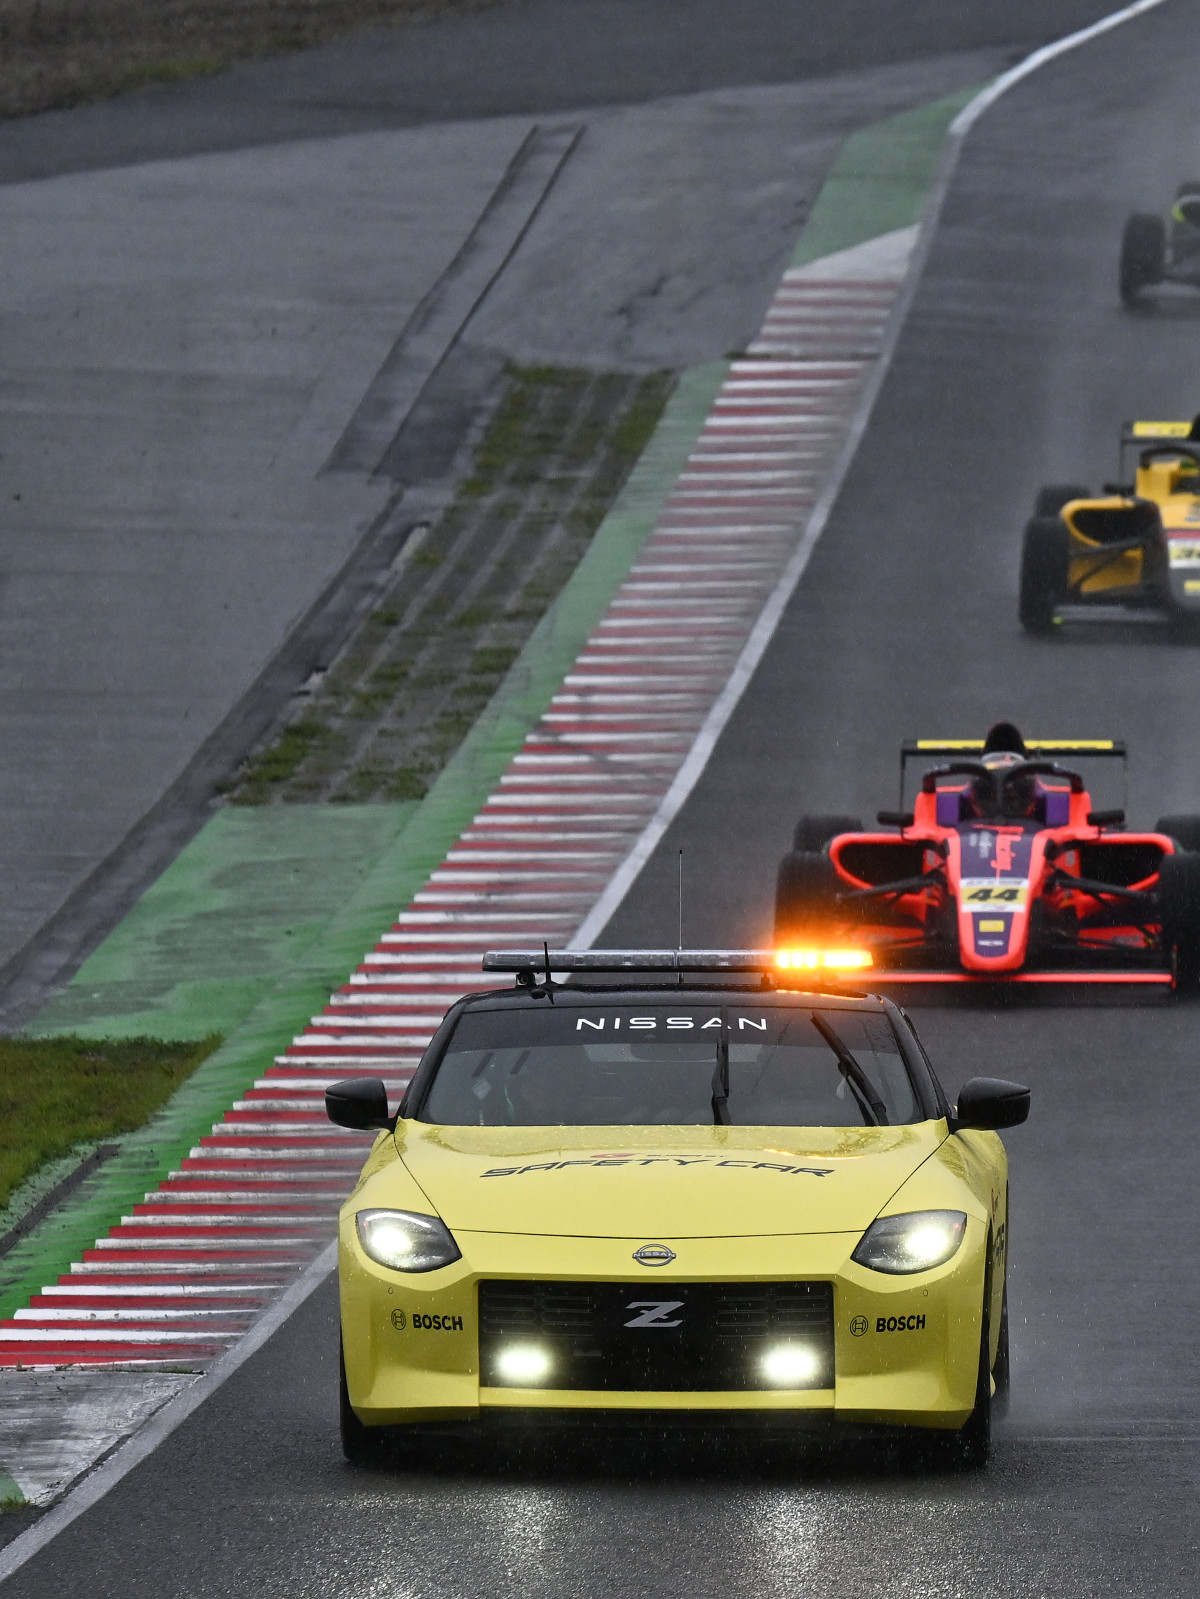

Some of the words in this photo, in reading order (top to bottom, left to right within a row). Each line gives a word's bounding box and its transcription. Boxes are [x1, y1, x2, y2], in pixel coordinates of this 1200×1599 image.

[967, 888, 1020, 902] 44
[576, 1017, 767, 1031] NISSAN
[479, 1158, 711, 1178] SAFETY
[714, 1160, 836, 1178] CAR
[633, 1250, 676, 1258] NISSAN
[412, 1313, 464, 1331] BOSCH
[623, 1301, 686, 1328] Z
[876, 1314, 926, 1333] BOSCH
